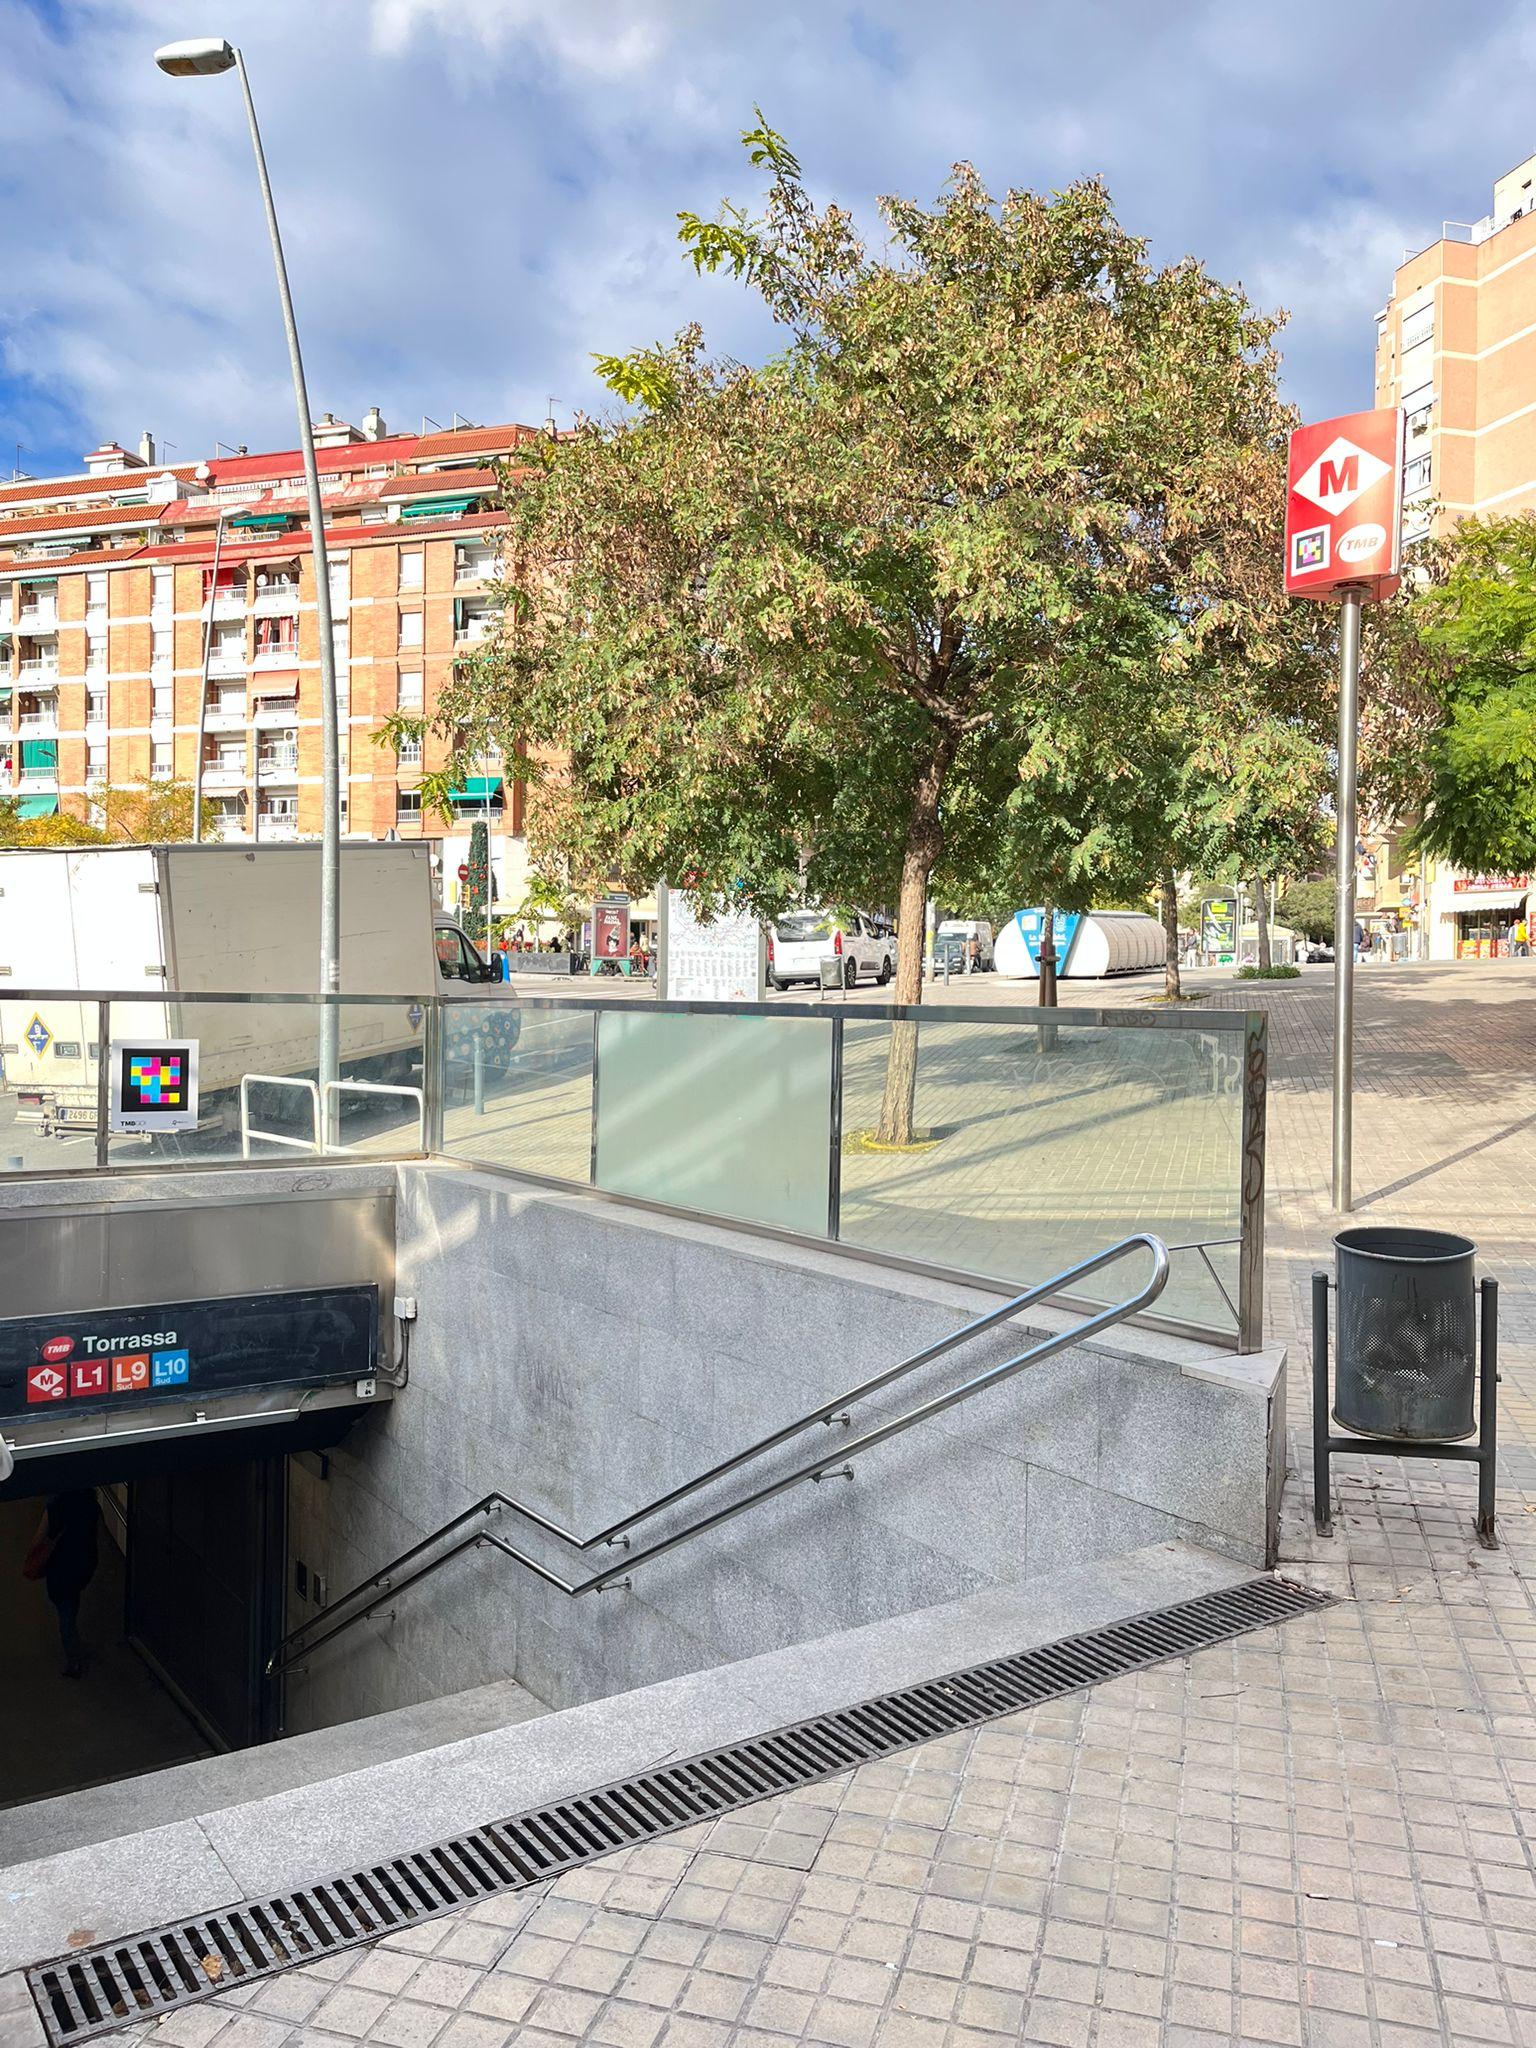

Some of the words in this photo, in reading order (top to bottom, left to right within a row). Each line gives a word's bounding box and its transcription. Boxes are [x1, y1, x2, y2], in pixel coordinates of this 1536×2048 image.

[1319, 454, 1359, 497] M
[1346, 537, 1378, 550] TMB
[47, 1344, 71, 1354] TMB
[82, 1331, 177, 1353] Torrassa
[77, 1366, 102, 1388] L1
[116, 1361, 146, 1383] L9
[155, 1357, 186, 1377] L10
[39, 1373, 54, 1386] M
[116, 1383, 133, 1391] Sud
[154, 1377, 171, 1385] Sud
